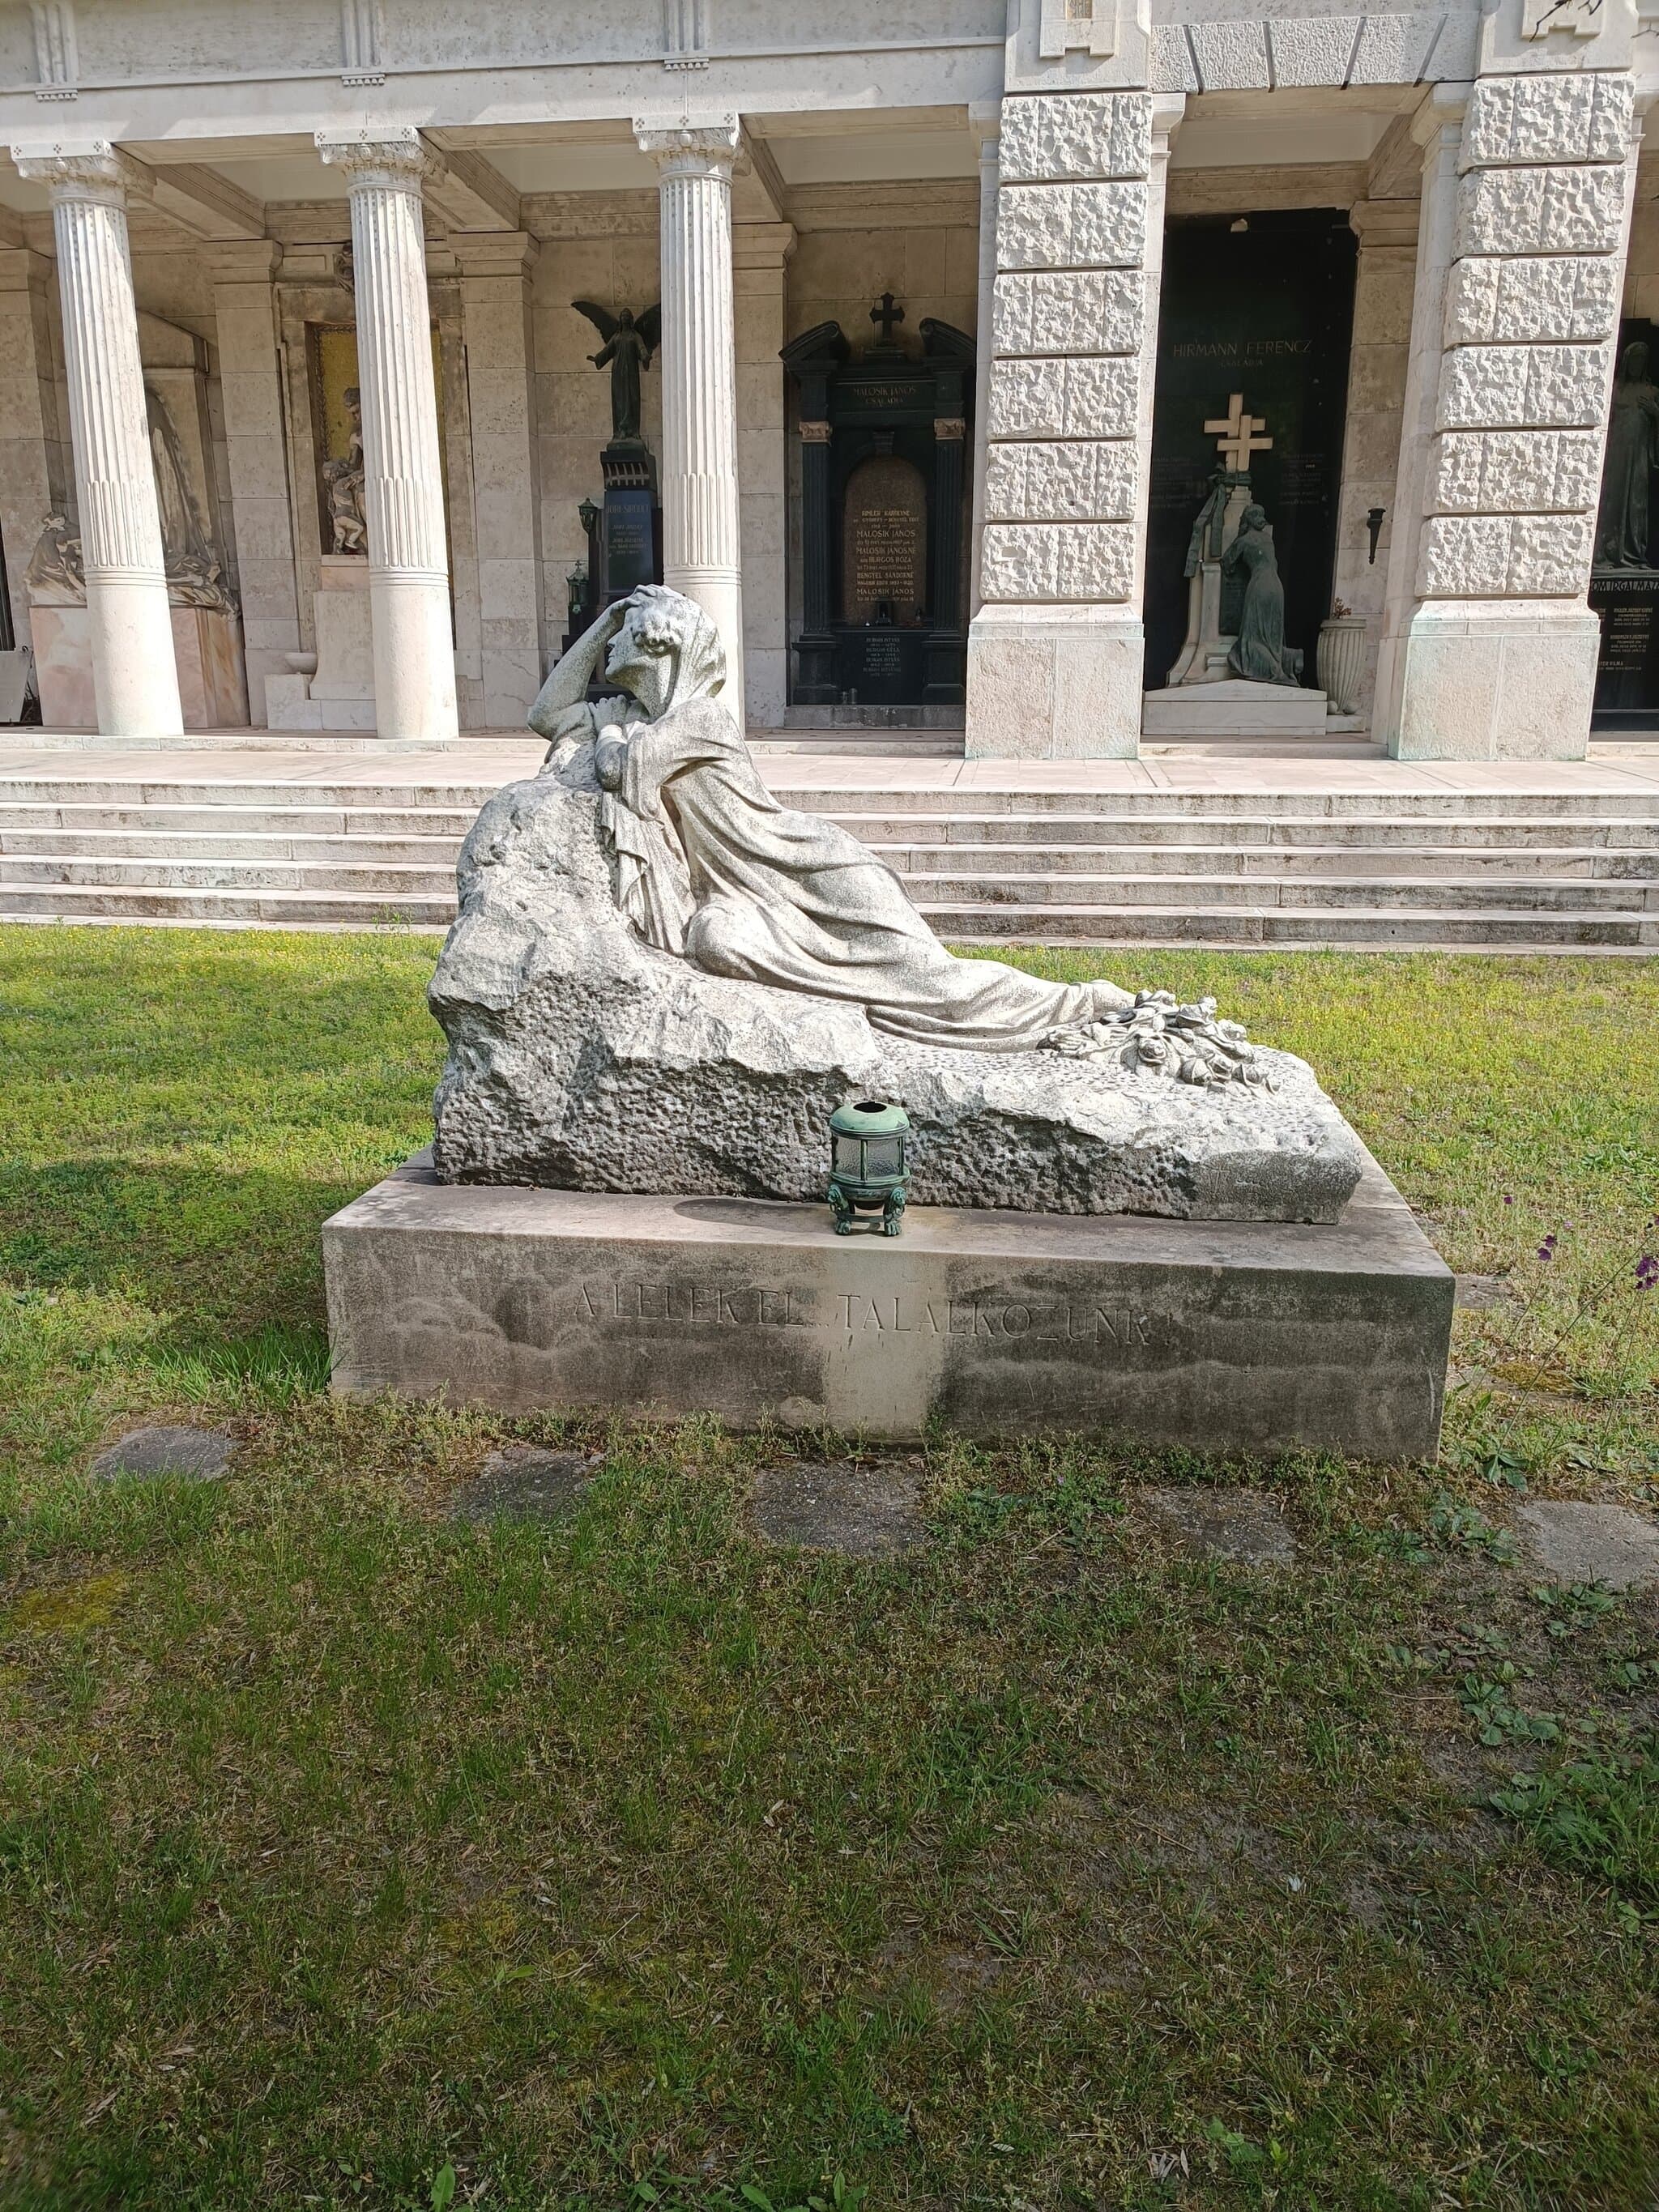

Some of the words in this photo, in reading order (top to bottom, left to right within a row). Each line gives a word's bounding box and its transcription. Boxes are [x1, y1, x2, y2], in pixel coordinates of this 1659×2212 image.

[1173, 343, 1237, 357] HIRMANN
[1246, 339, 1312, 356] FERENCZ
[856, 530, 889, 538] MALOSIK
[574, 1283, 597, 1318] A
